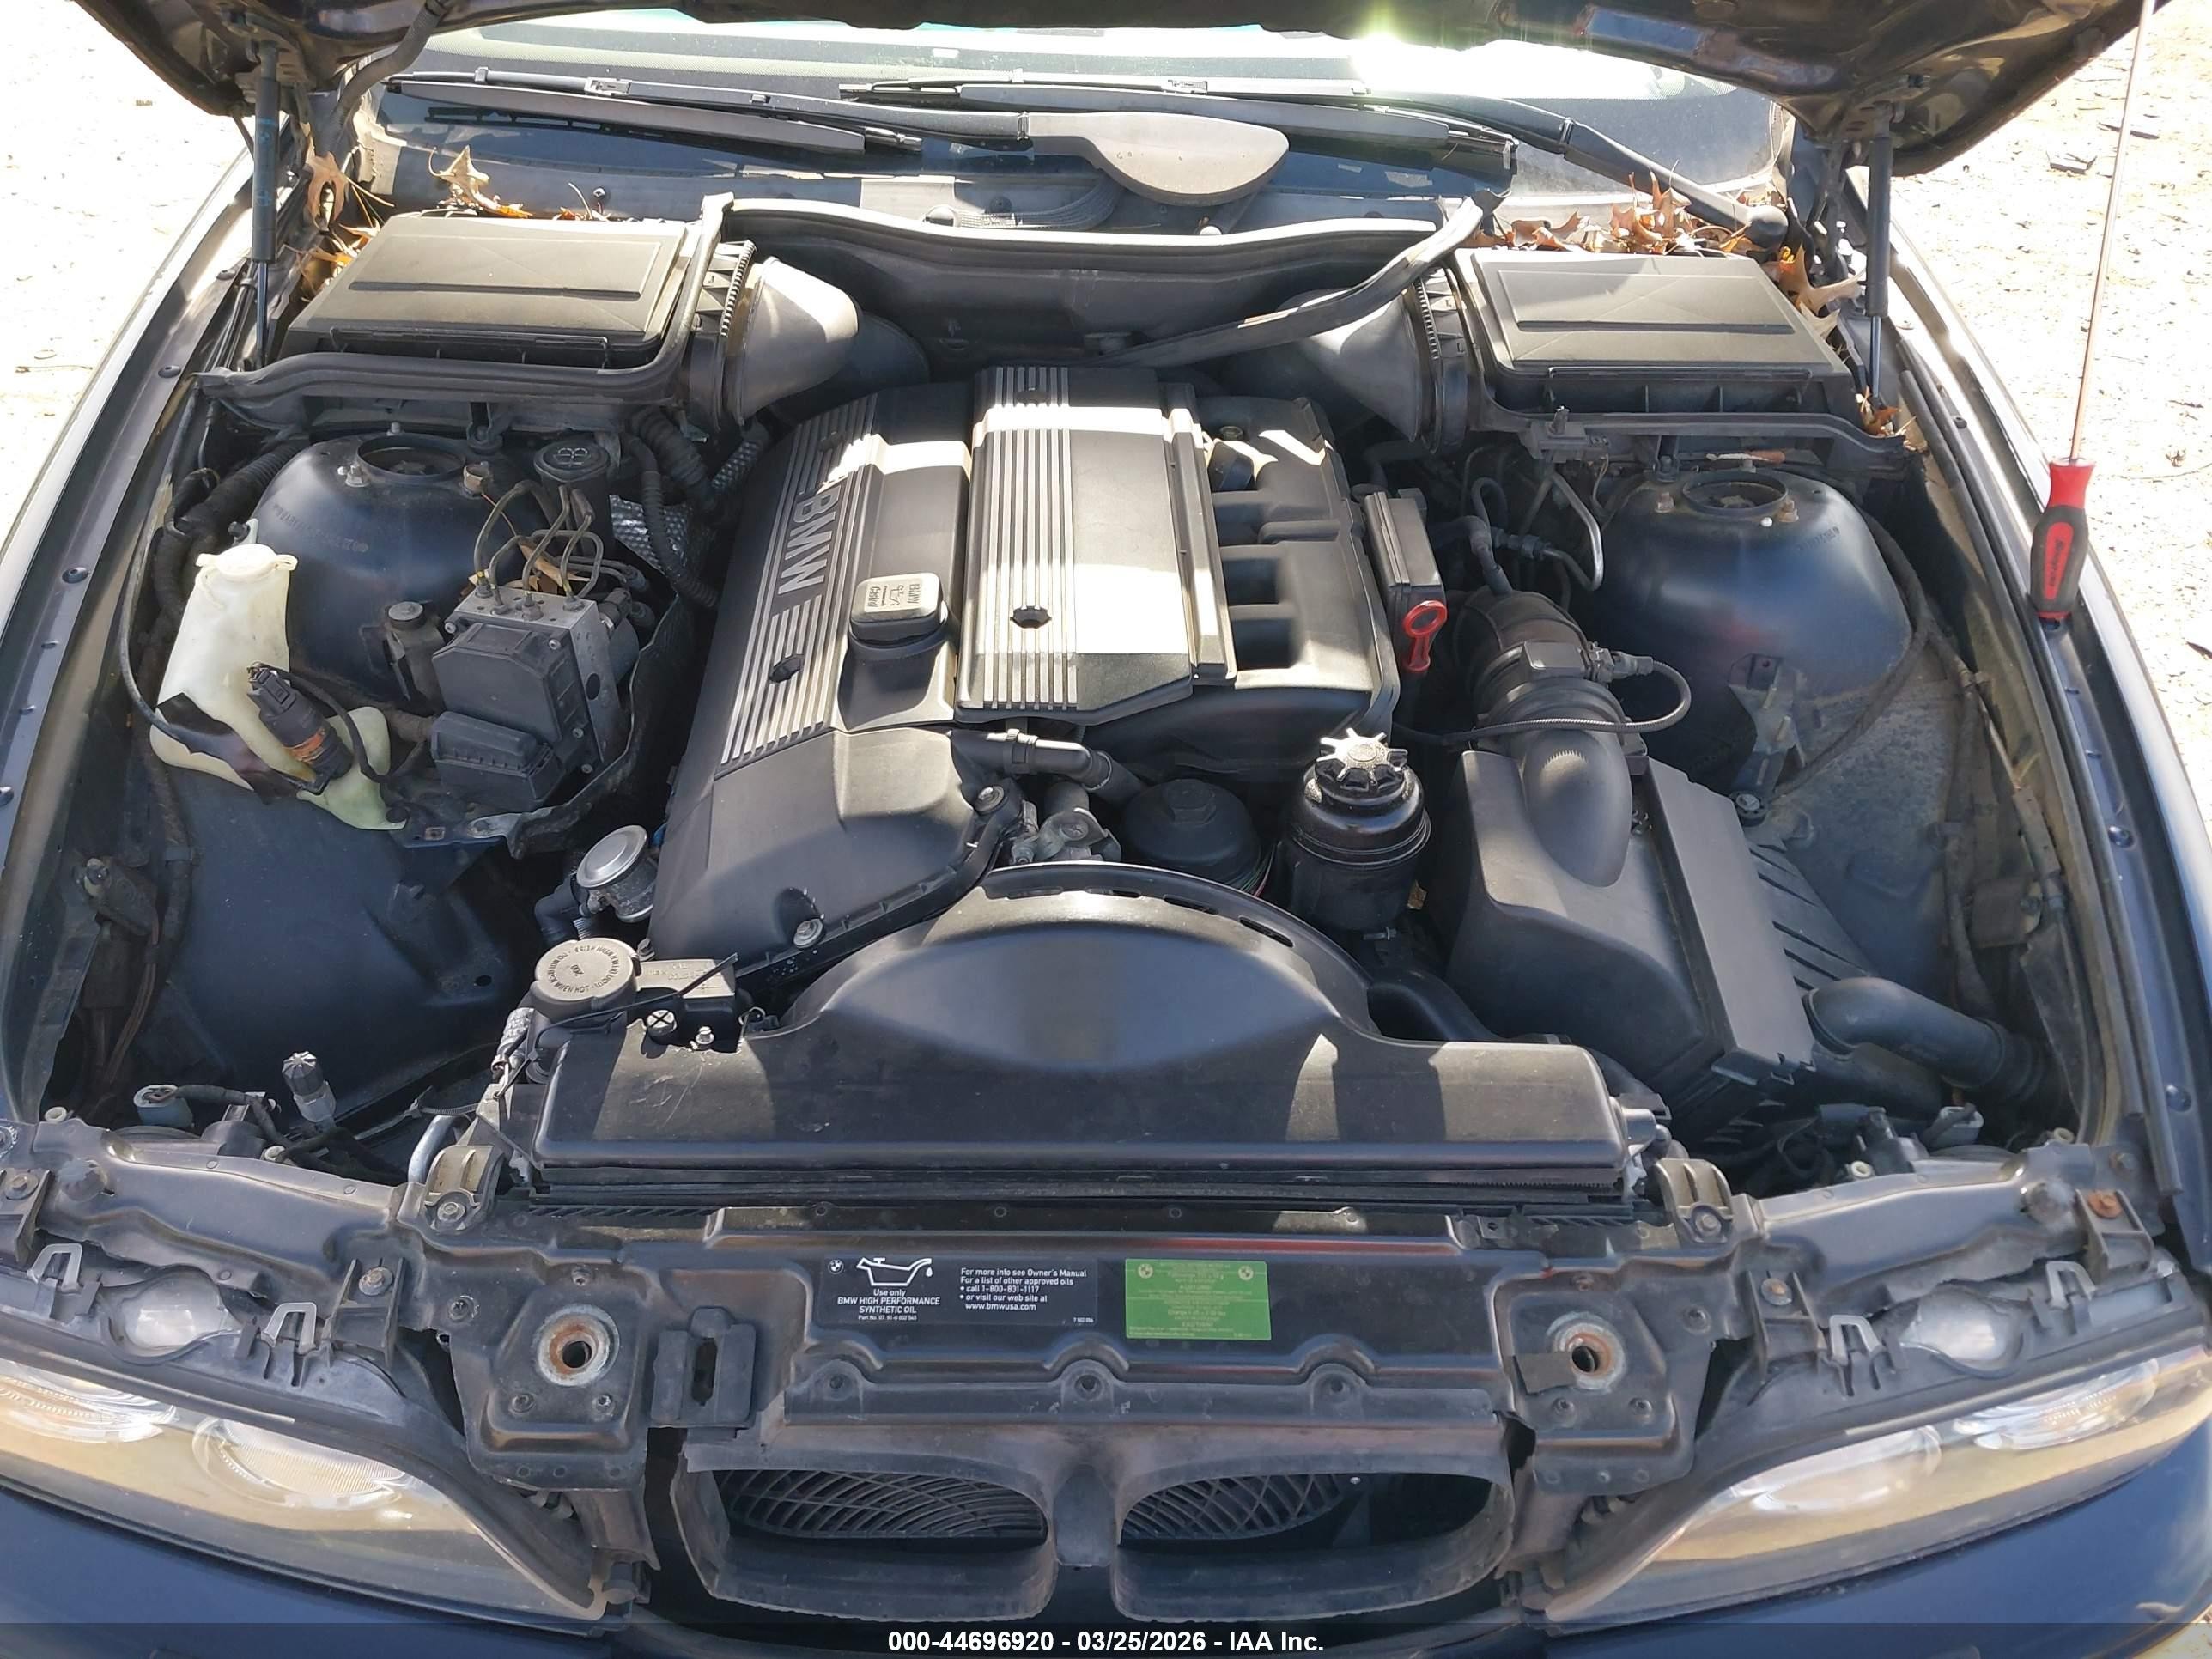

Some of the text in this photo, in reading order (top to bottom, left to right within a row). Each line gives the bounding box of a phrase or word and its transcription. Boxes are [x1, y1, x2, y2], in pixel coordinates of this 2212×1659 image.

[778, 485, 841, 595] BMW
[907, 583, 921, 604] BMW
[1027, 1268, 1057, 1277] Owner's
[1024, 1279, 1059, 1287] approved
[889, 1289, 906, 1297] only
[981, 1285, 1039, 1293] 1-800-831-1117
[965, 1303, 1036, 1311] www.bmwusa.com
